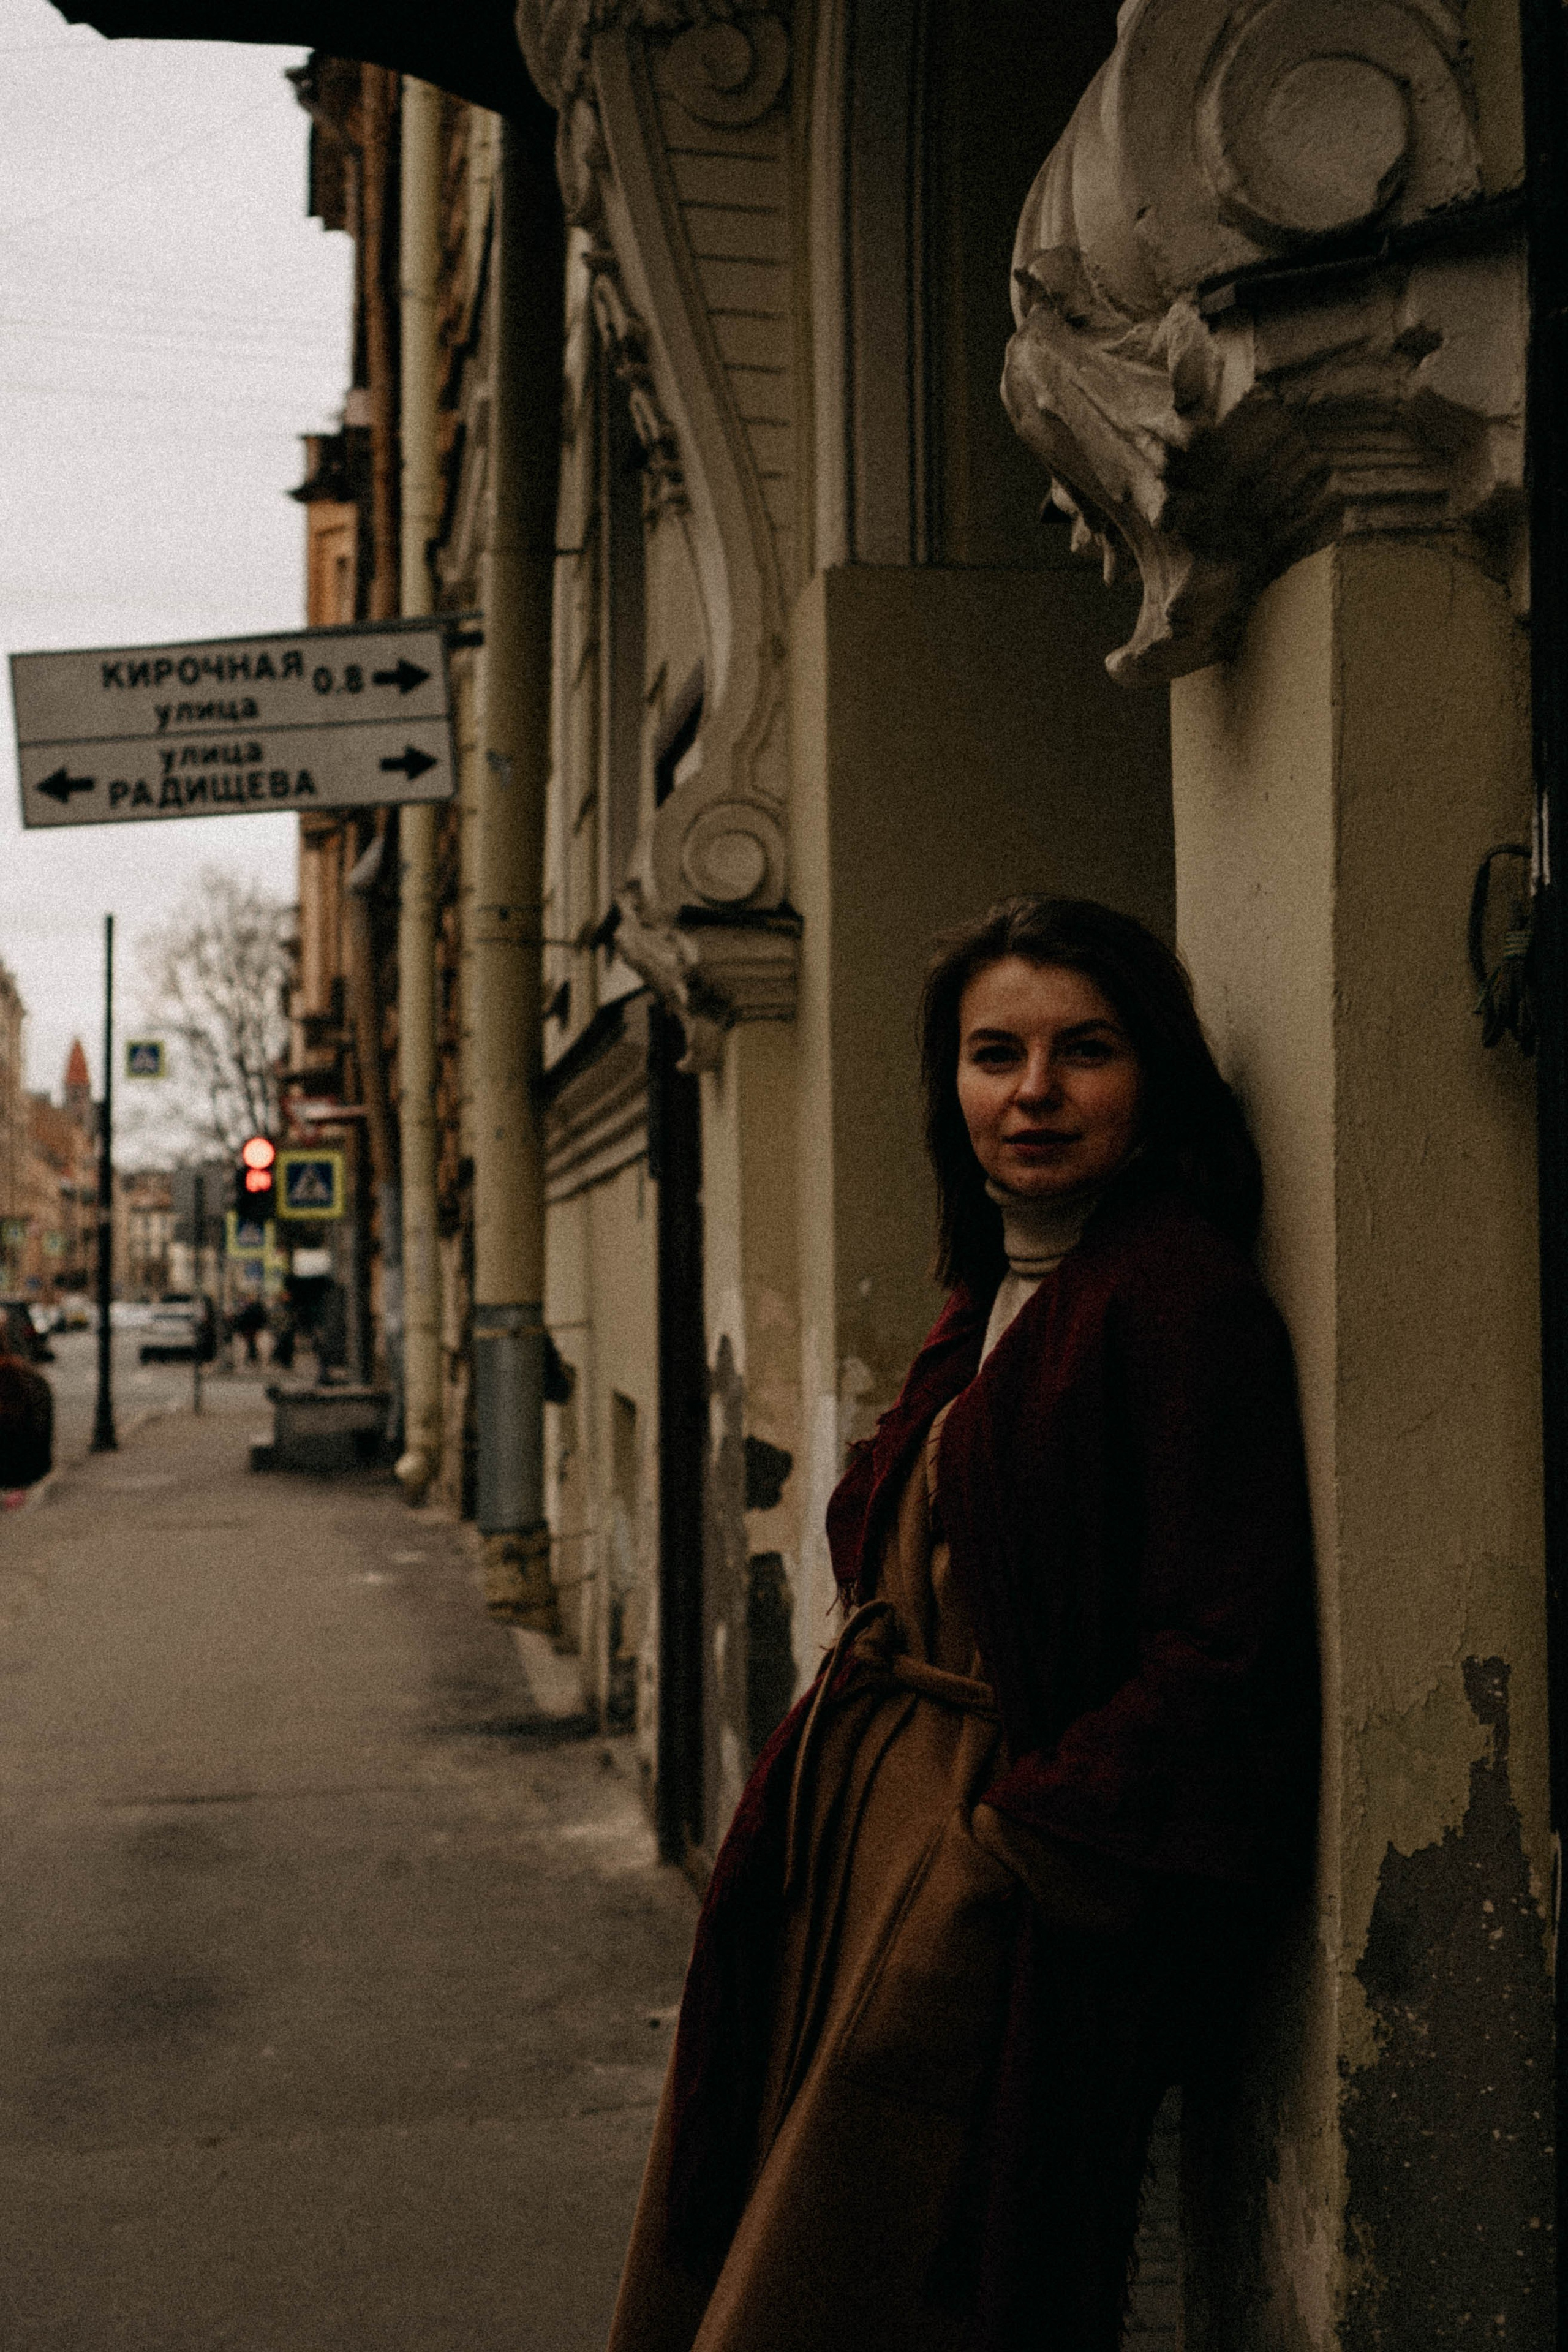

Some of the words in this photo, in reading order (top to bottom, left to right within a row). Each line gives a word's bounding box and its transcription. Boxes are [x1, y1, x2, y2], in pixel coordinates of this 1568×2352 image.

[102, 650, 304, 688] КИРОЧНАЯ
[155, 697, 258, 731] улица
[160, 741, 262, 772] улица
[109, 770, 316, 808] РАДИЩЕВА
